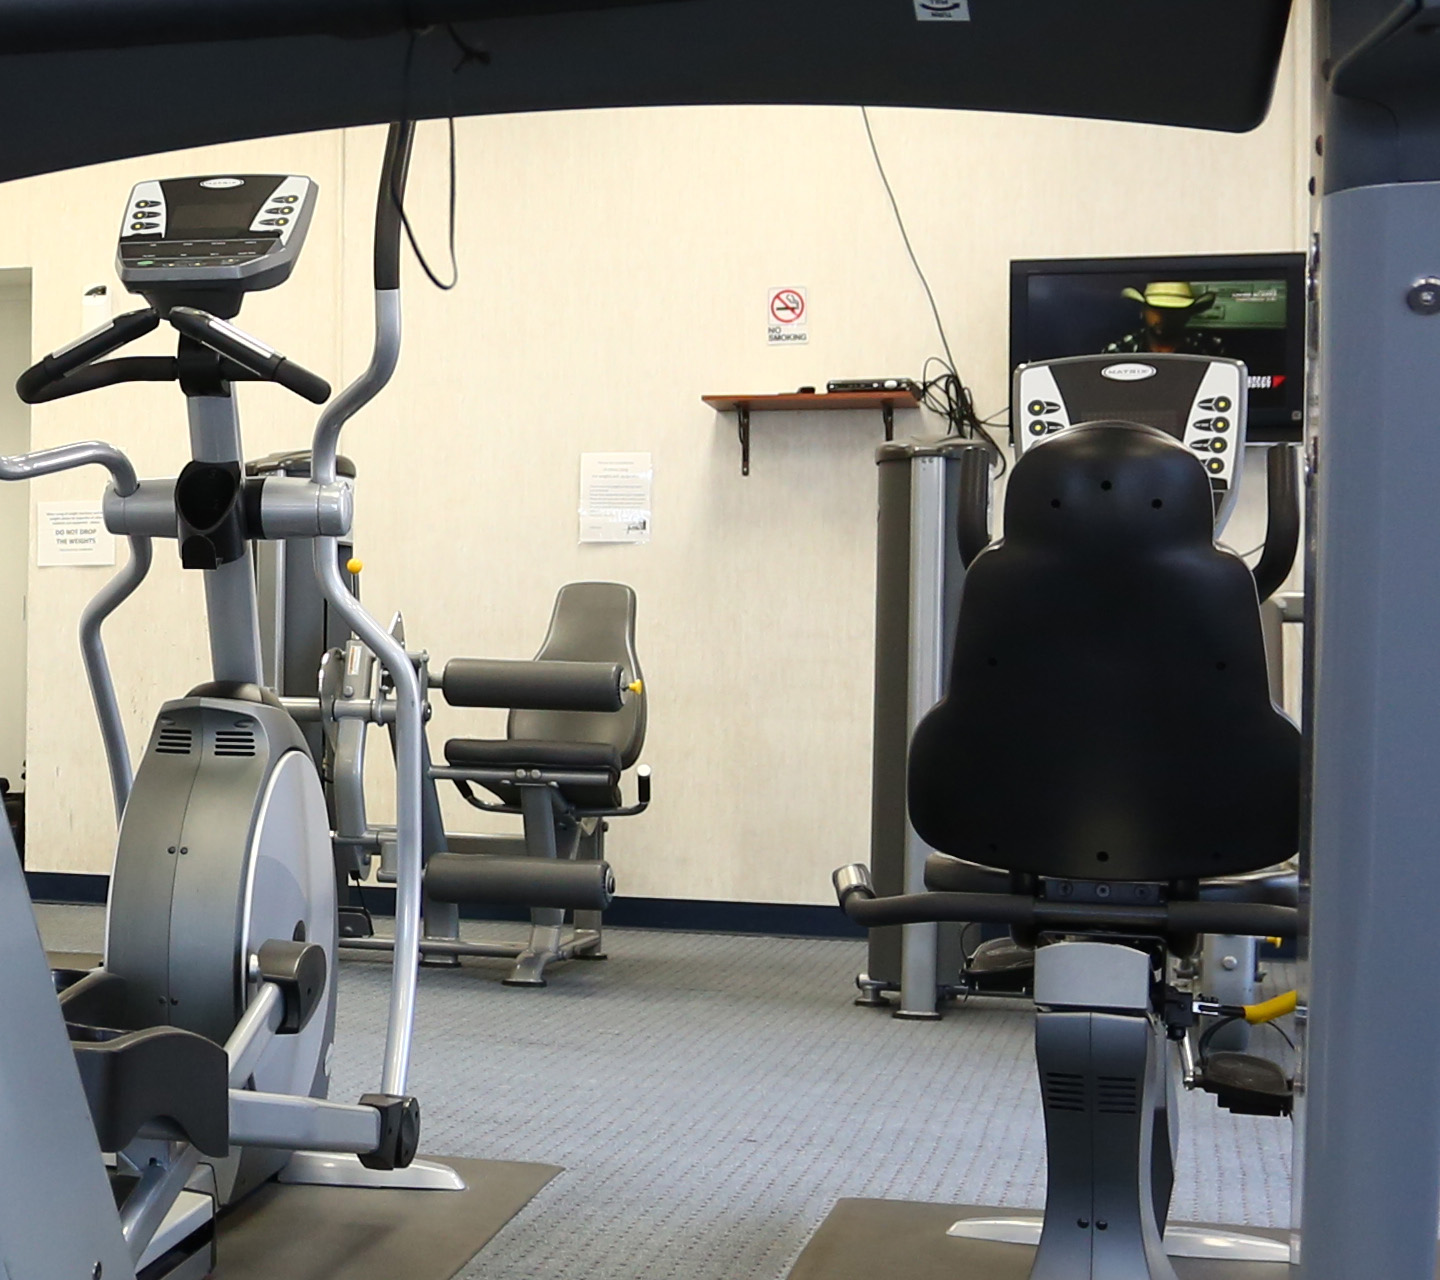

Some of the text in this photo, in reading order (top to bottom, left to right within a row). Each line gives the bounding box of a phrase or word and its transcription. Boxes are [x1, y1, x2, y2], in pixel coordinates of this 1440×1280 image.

[768, 326, 781, 334] NO
[768, 333, 807, 342] SMOKING
[66, 528, 78, 536] NOT
[69, 537, 96, 545] WEIGHTS
